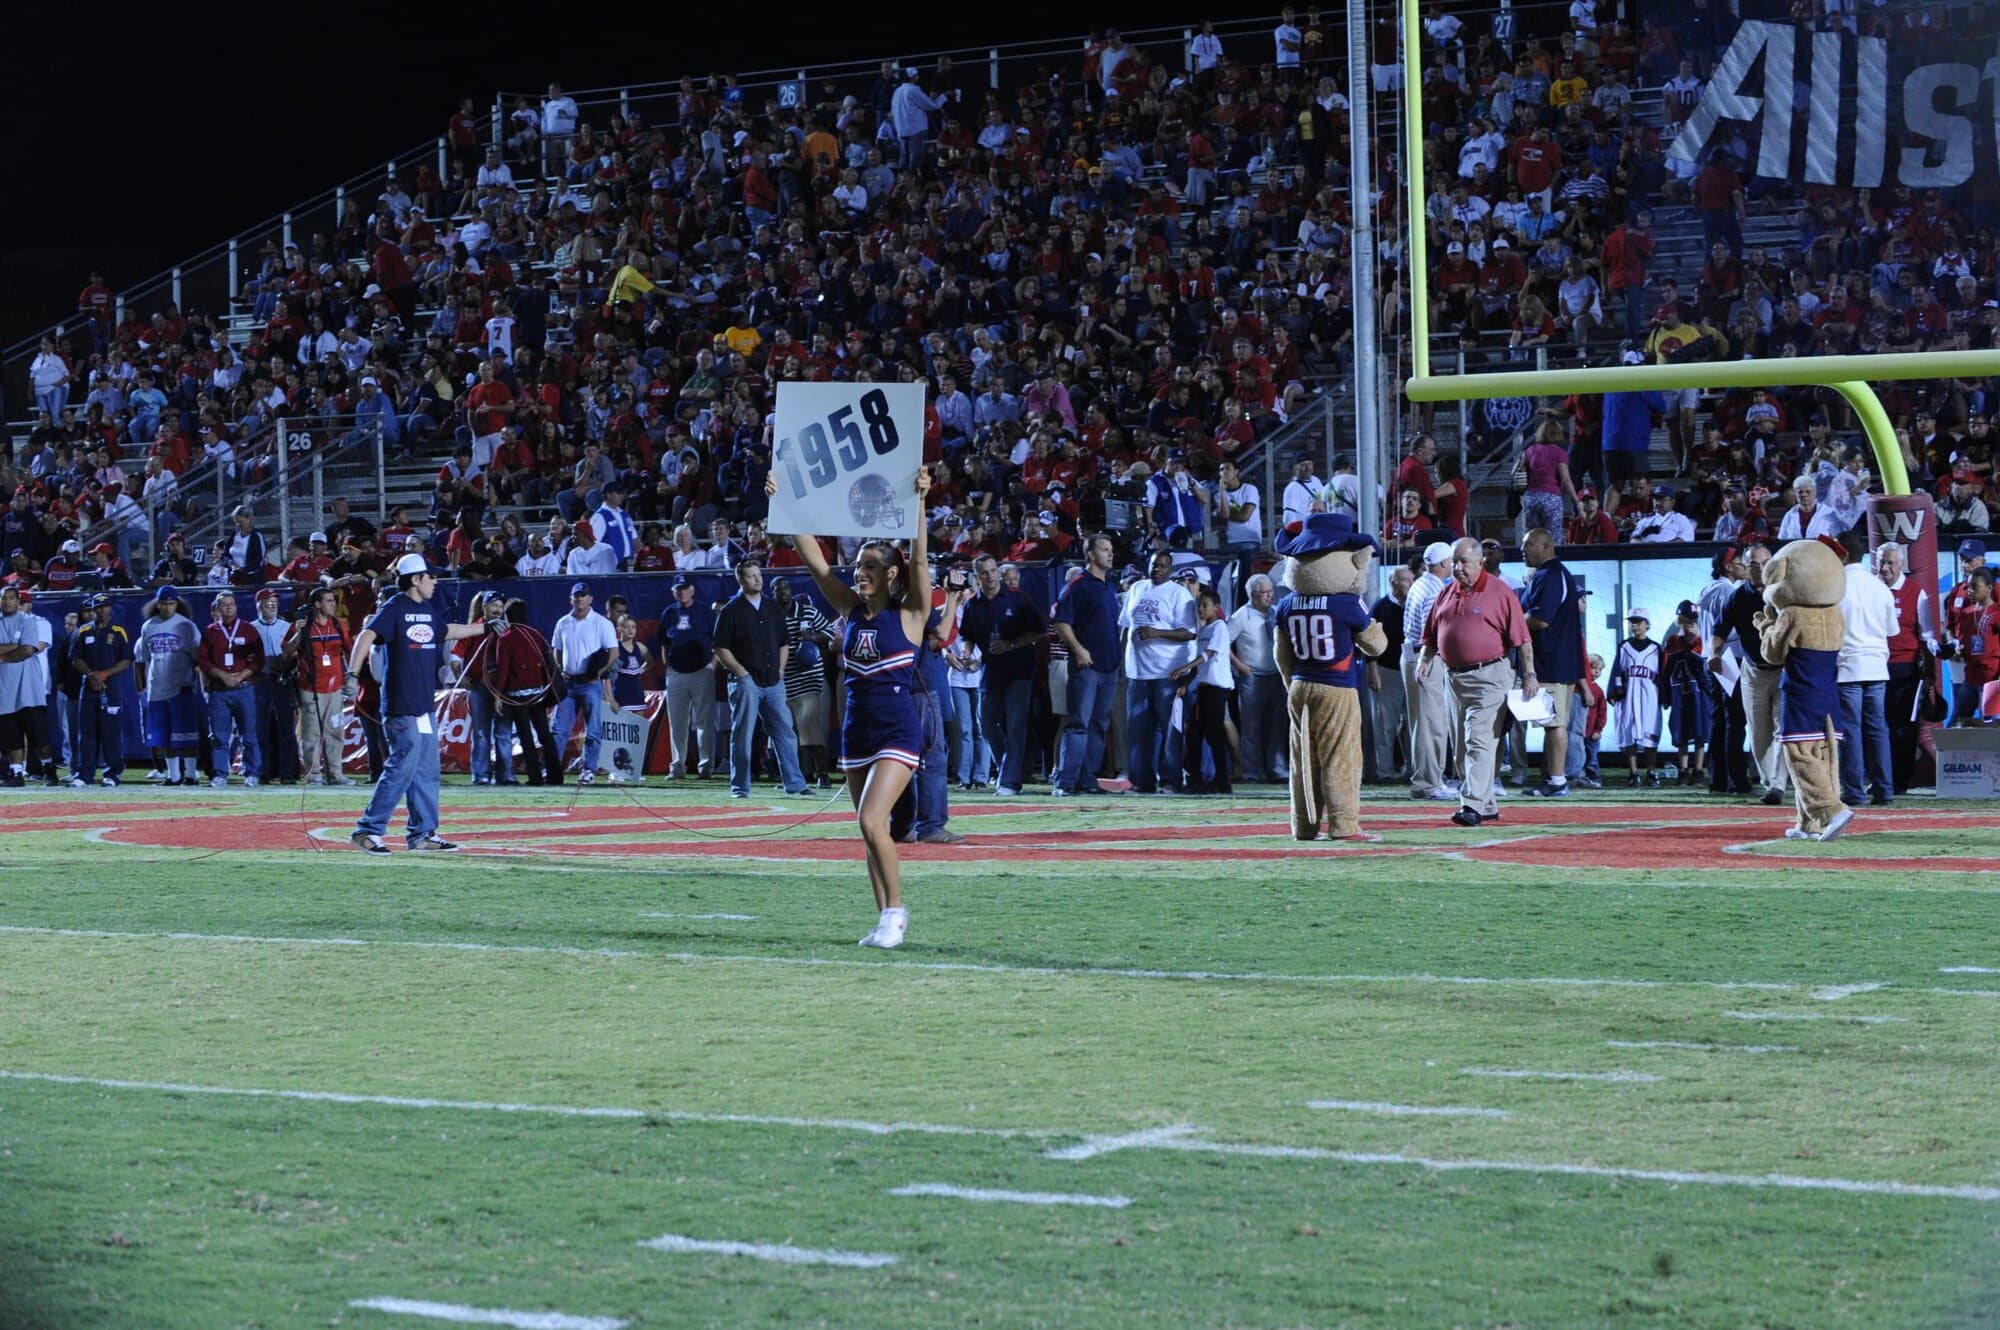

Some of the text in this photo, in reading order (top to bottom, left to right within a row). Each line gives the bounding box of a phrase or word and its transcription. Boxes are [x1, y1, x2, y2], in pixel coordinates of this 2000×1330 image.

[1494, 15, 1513, 39] 27
[780, 84, 797, 106] 26
[288, 431, 312, 451] 26
[776, 388, 900, 500] 1958
[193, 548, 205, 564] 27
[851, 629, 881, 661] A
[1287, 614, 1336, 661] 08
[1943, 763, 1982, 774] GILDAN
